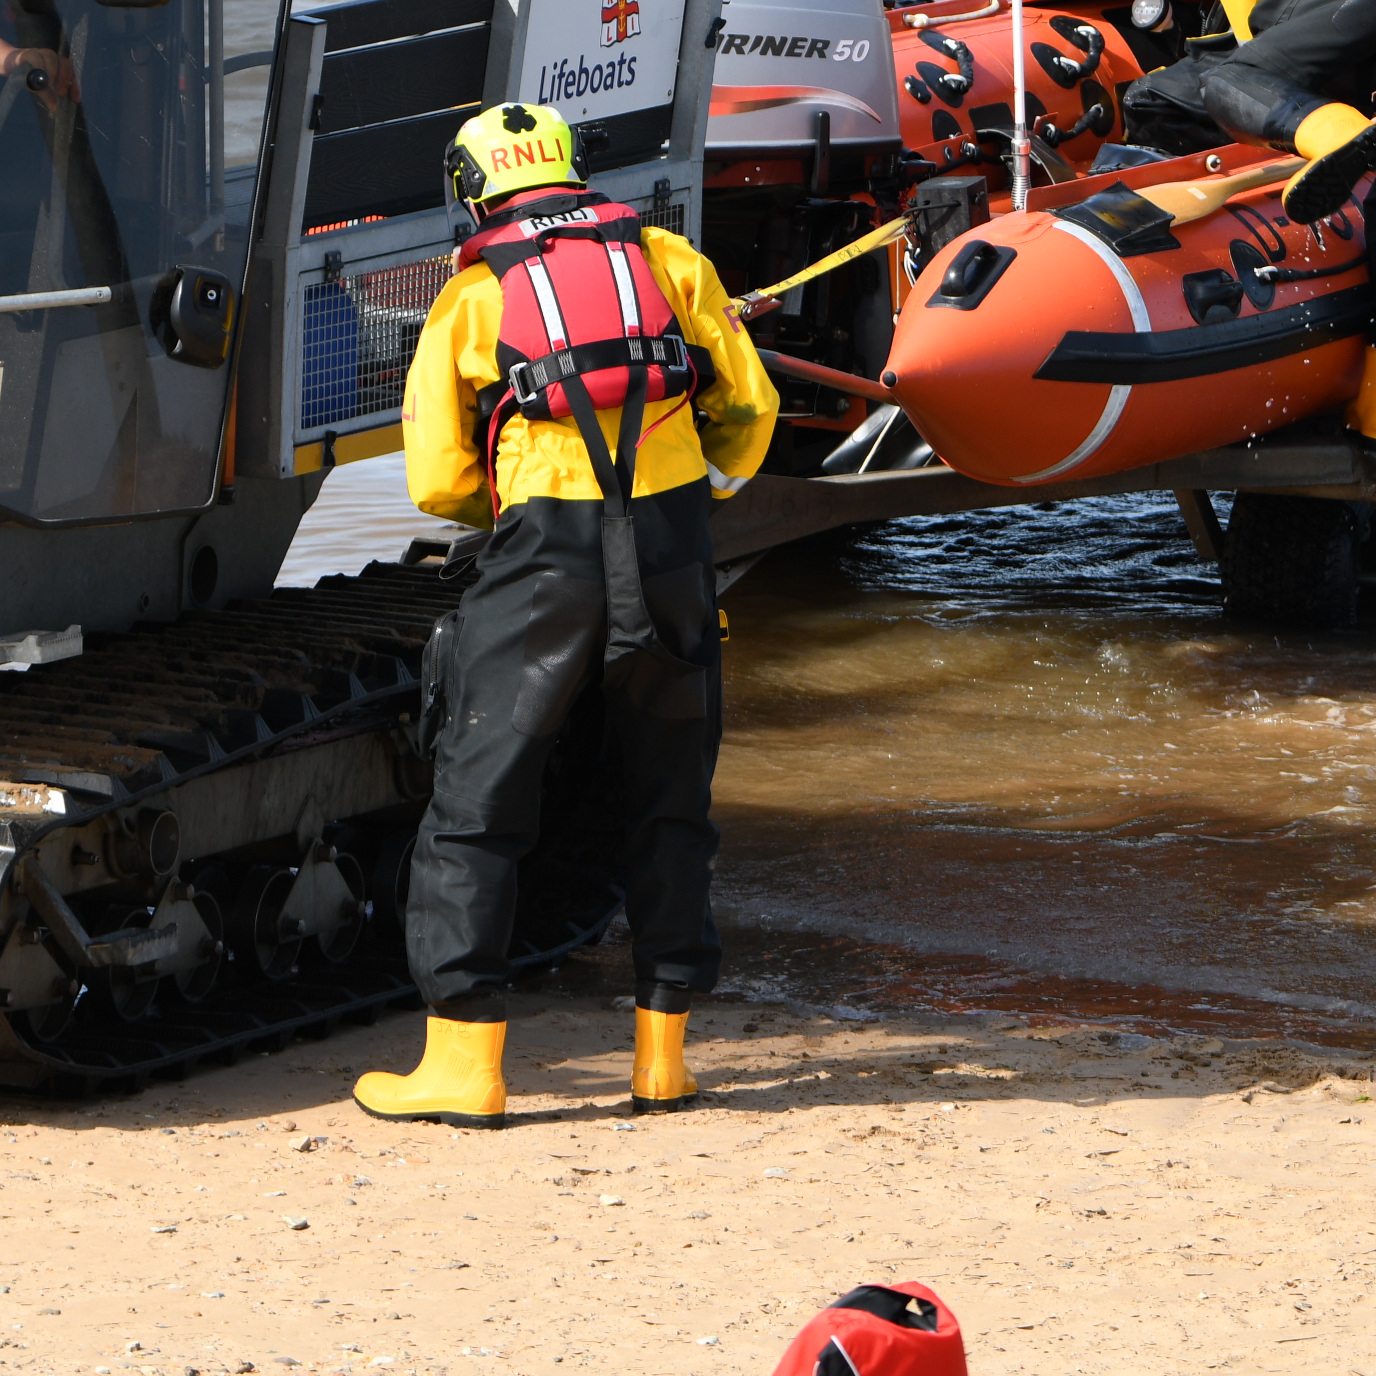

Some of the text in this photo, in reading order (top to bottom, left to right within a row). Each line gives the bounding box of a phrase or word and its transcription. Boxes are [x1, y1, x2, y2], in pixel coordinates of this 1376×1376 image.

[832, 39, 870, 62] 50
[537, 51, 637, 105] Lifeboats
[490, 138, 565, 173] RNLI
[529, 209, 589, 230] RNLI
